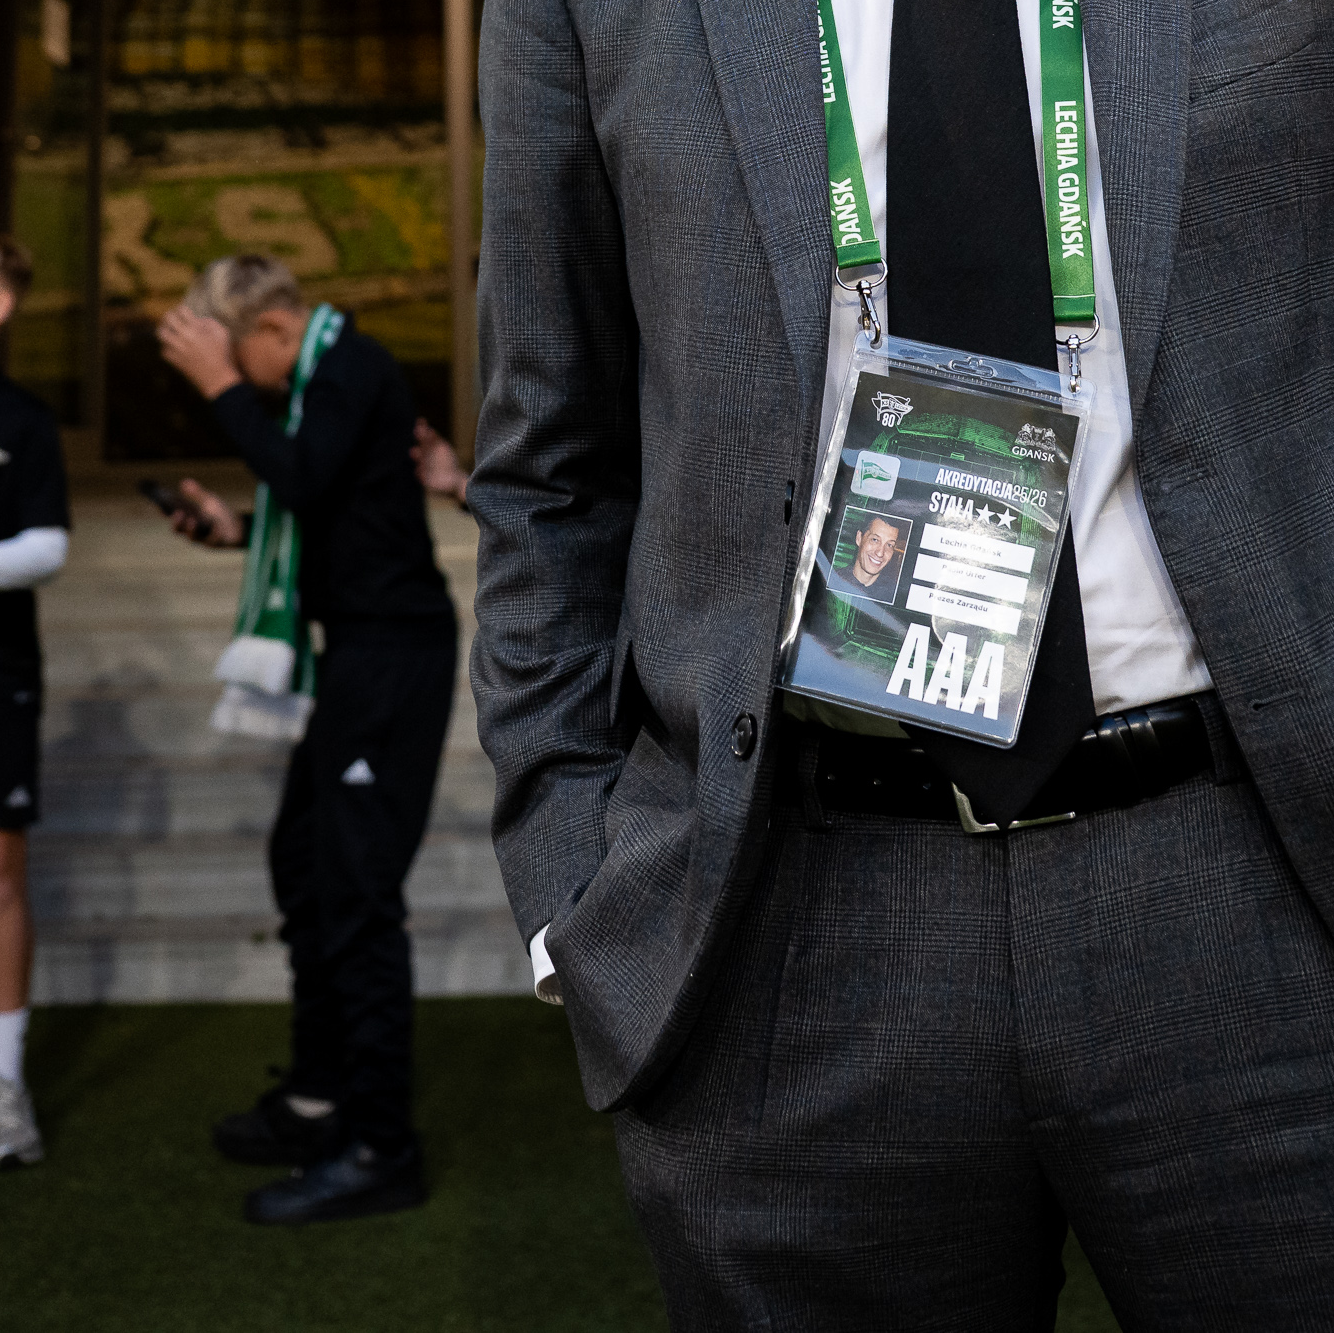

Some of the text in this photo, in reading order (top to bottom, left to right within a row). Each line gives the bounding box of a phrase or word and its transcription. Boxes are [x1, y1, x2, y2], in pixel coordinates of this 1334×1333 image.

[1055, 100, 1086, 259] LECHIA GDAŃSK
[882, 412, 896, 427] 80
[1011, 445, 1056, 463] GDAŃSK
[935, 468, 1013, 500] AKREDYTACJA
[928, 491, 975, 520] STAŁA
[885, 622, 1005, 721] AAA
